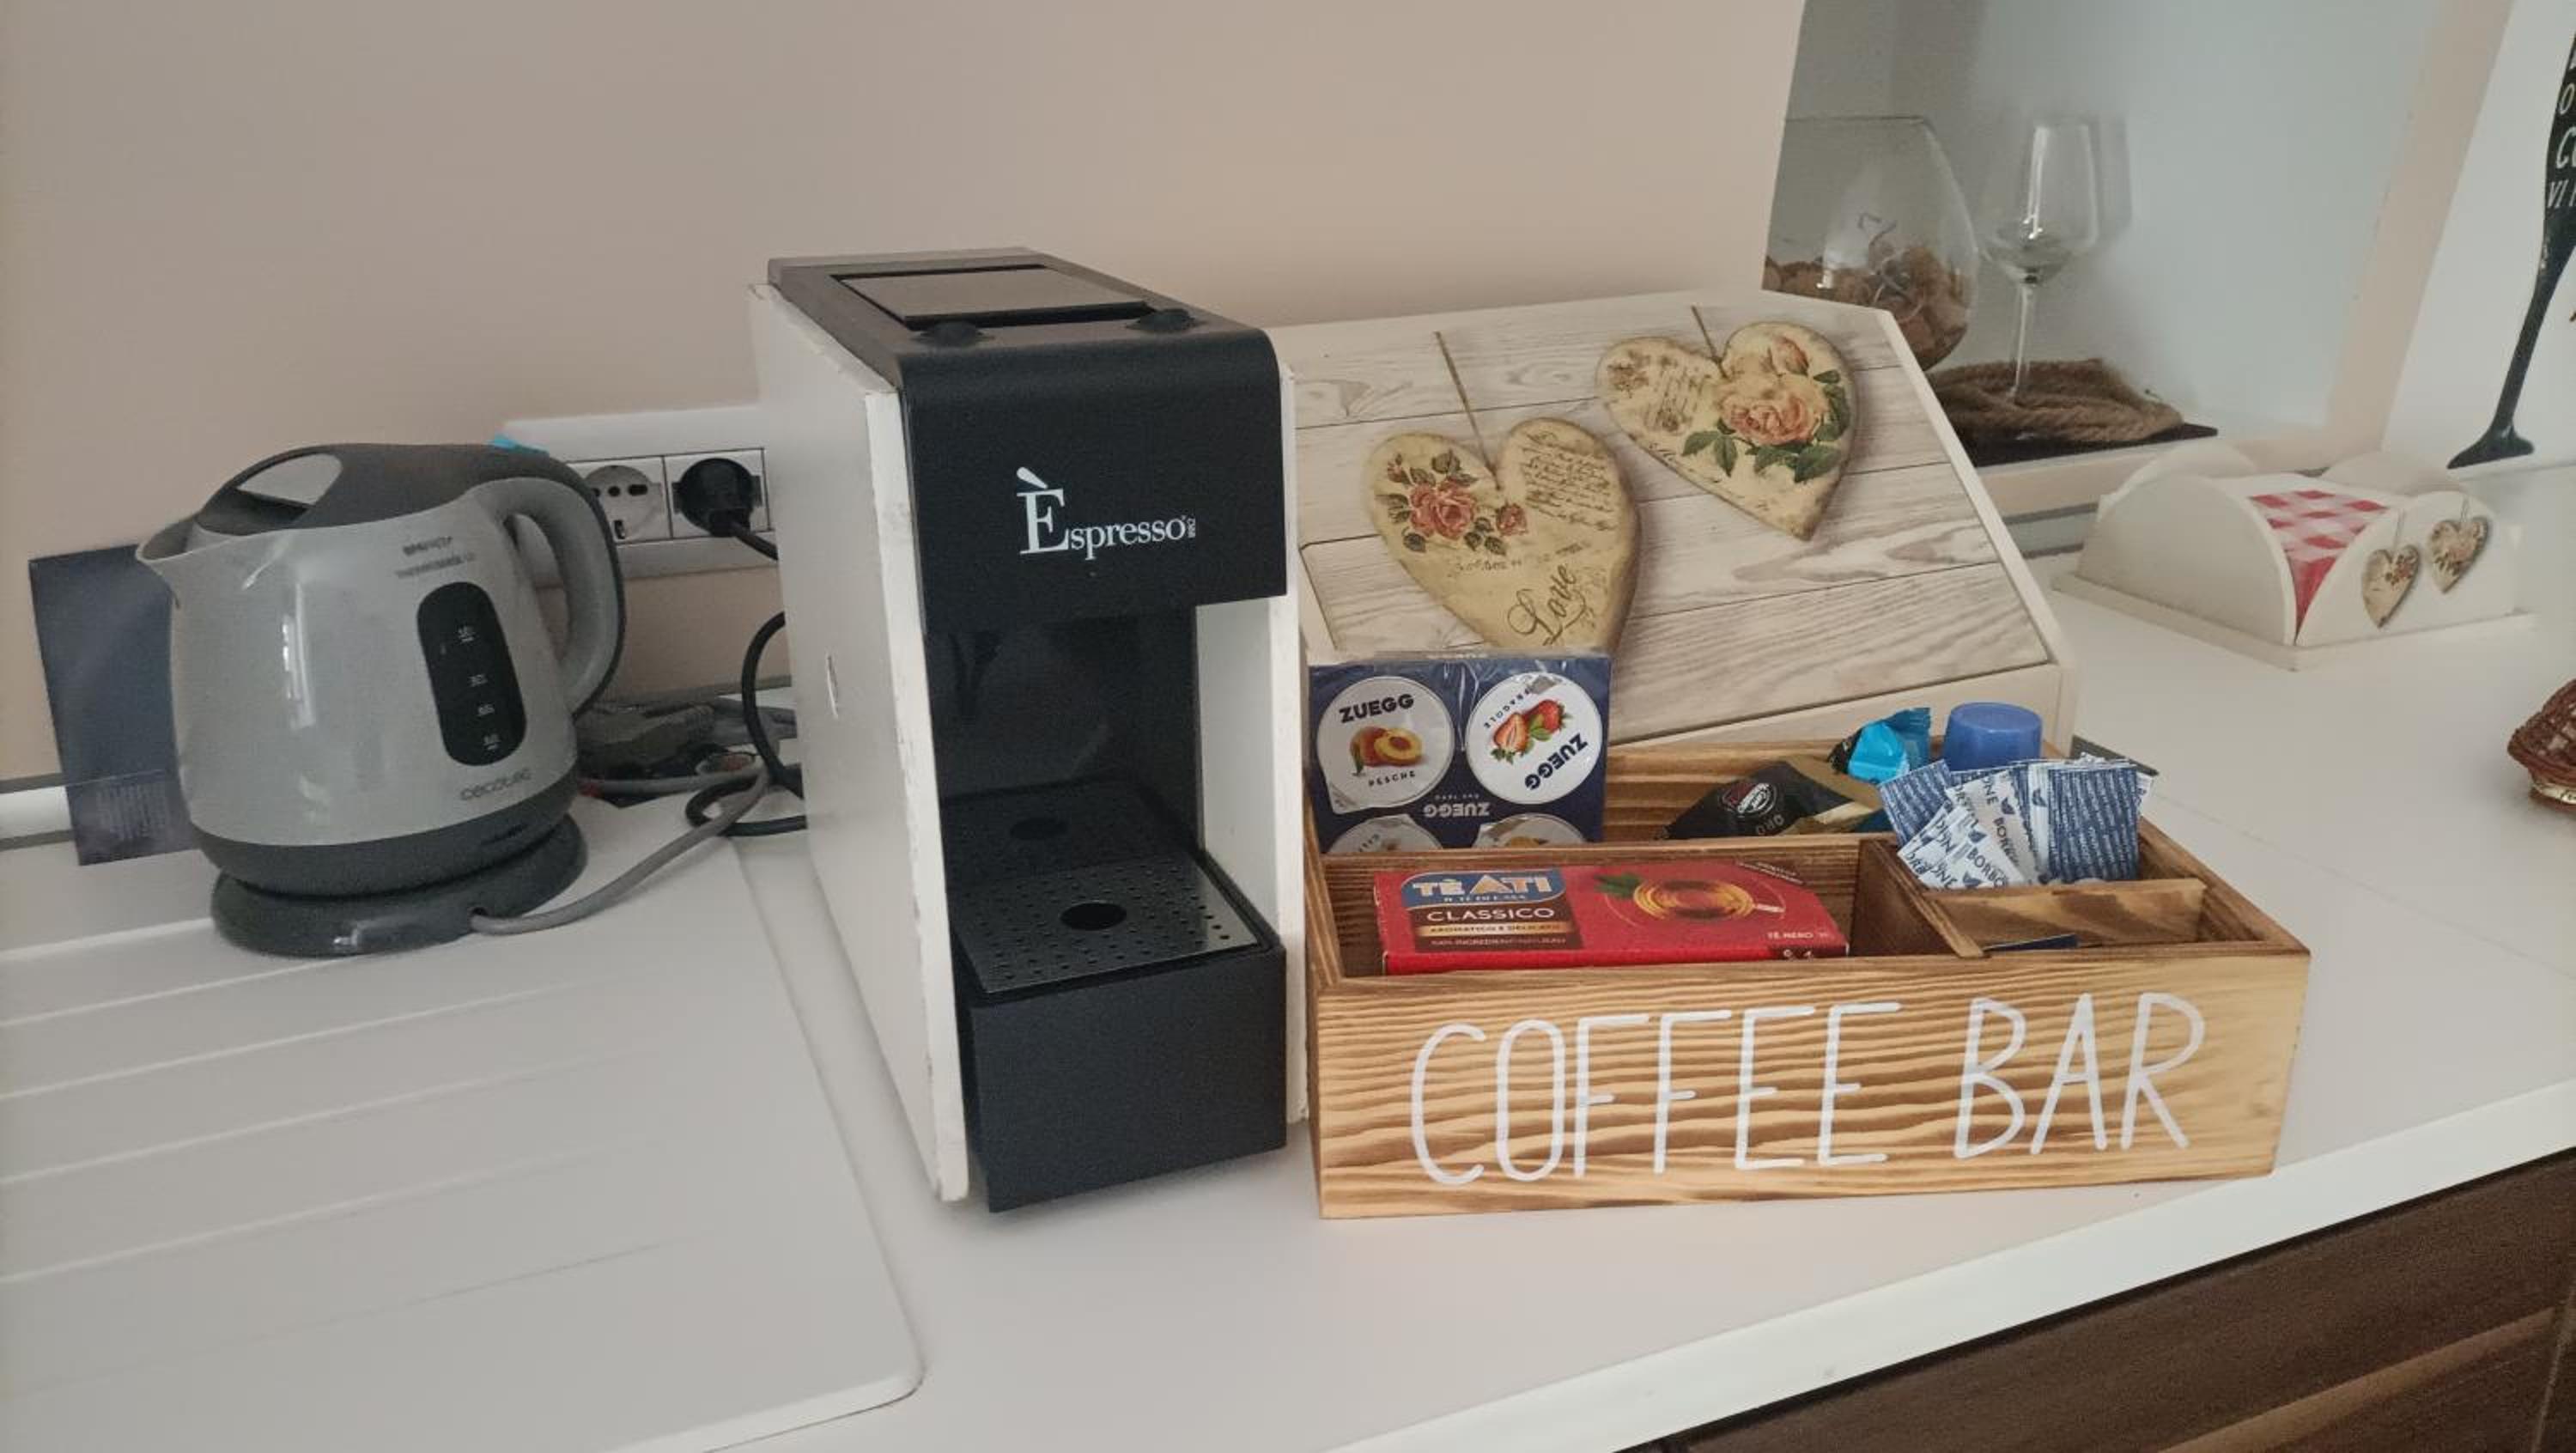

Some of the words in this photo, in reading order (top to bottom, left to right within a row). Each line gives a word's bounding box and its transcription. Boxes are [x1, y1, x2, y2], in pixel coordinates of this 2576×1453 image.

[1016, 466, 1187, 561] Èspresso
[1507, 564, 1587, 646] Love
[1340, 693, 1414, 724] ZUEGG
[1525, 733, 1588, 791] ZUEGG
[1368, 769, 1416, 787] PESCHE
[1423, 801, 1491, 818] ZUEGG
[1755, 813, 1785, 835] ORO
[1426, 907, 1555, 922] CLASSICO
[1410, 1000, 1902, 1187] COFFEE
[1954, 992, 2206, 1159] BAR
